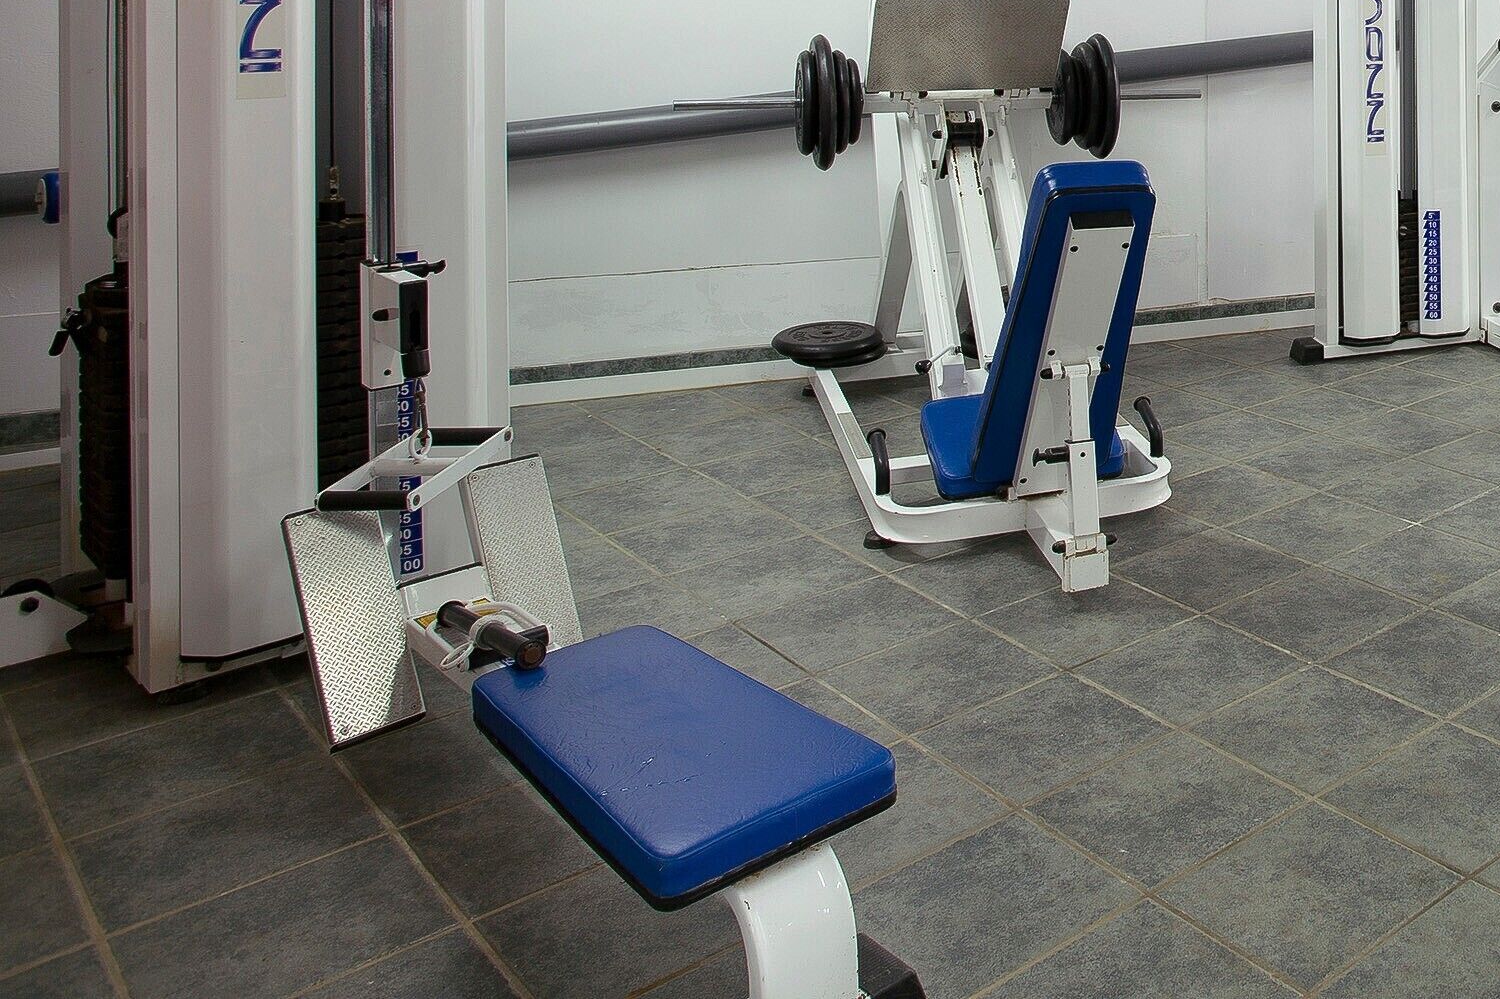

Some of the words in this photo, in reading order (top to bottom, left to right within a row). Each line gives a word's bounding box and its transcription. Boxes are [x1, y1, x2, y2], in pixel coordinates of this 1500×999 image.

[399, 481, 410, 491] 5
[400, 513, 411, 523] 5
[404, 559, 420, 571] 00
